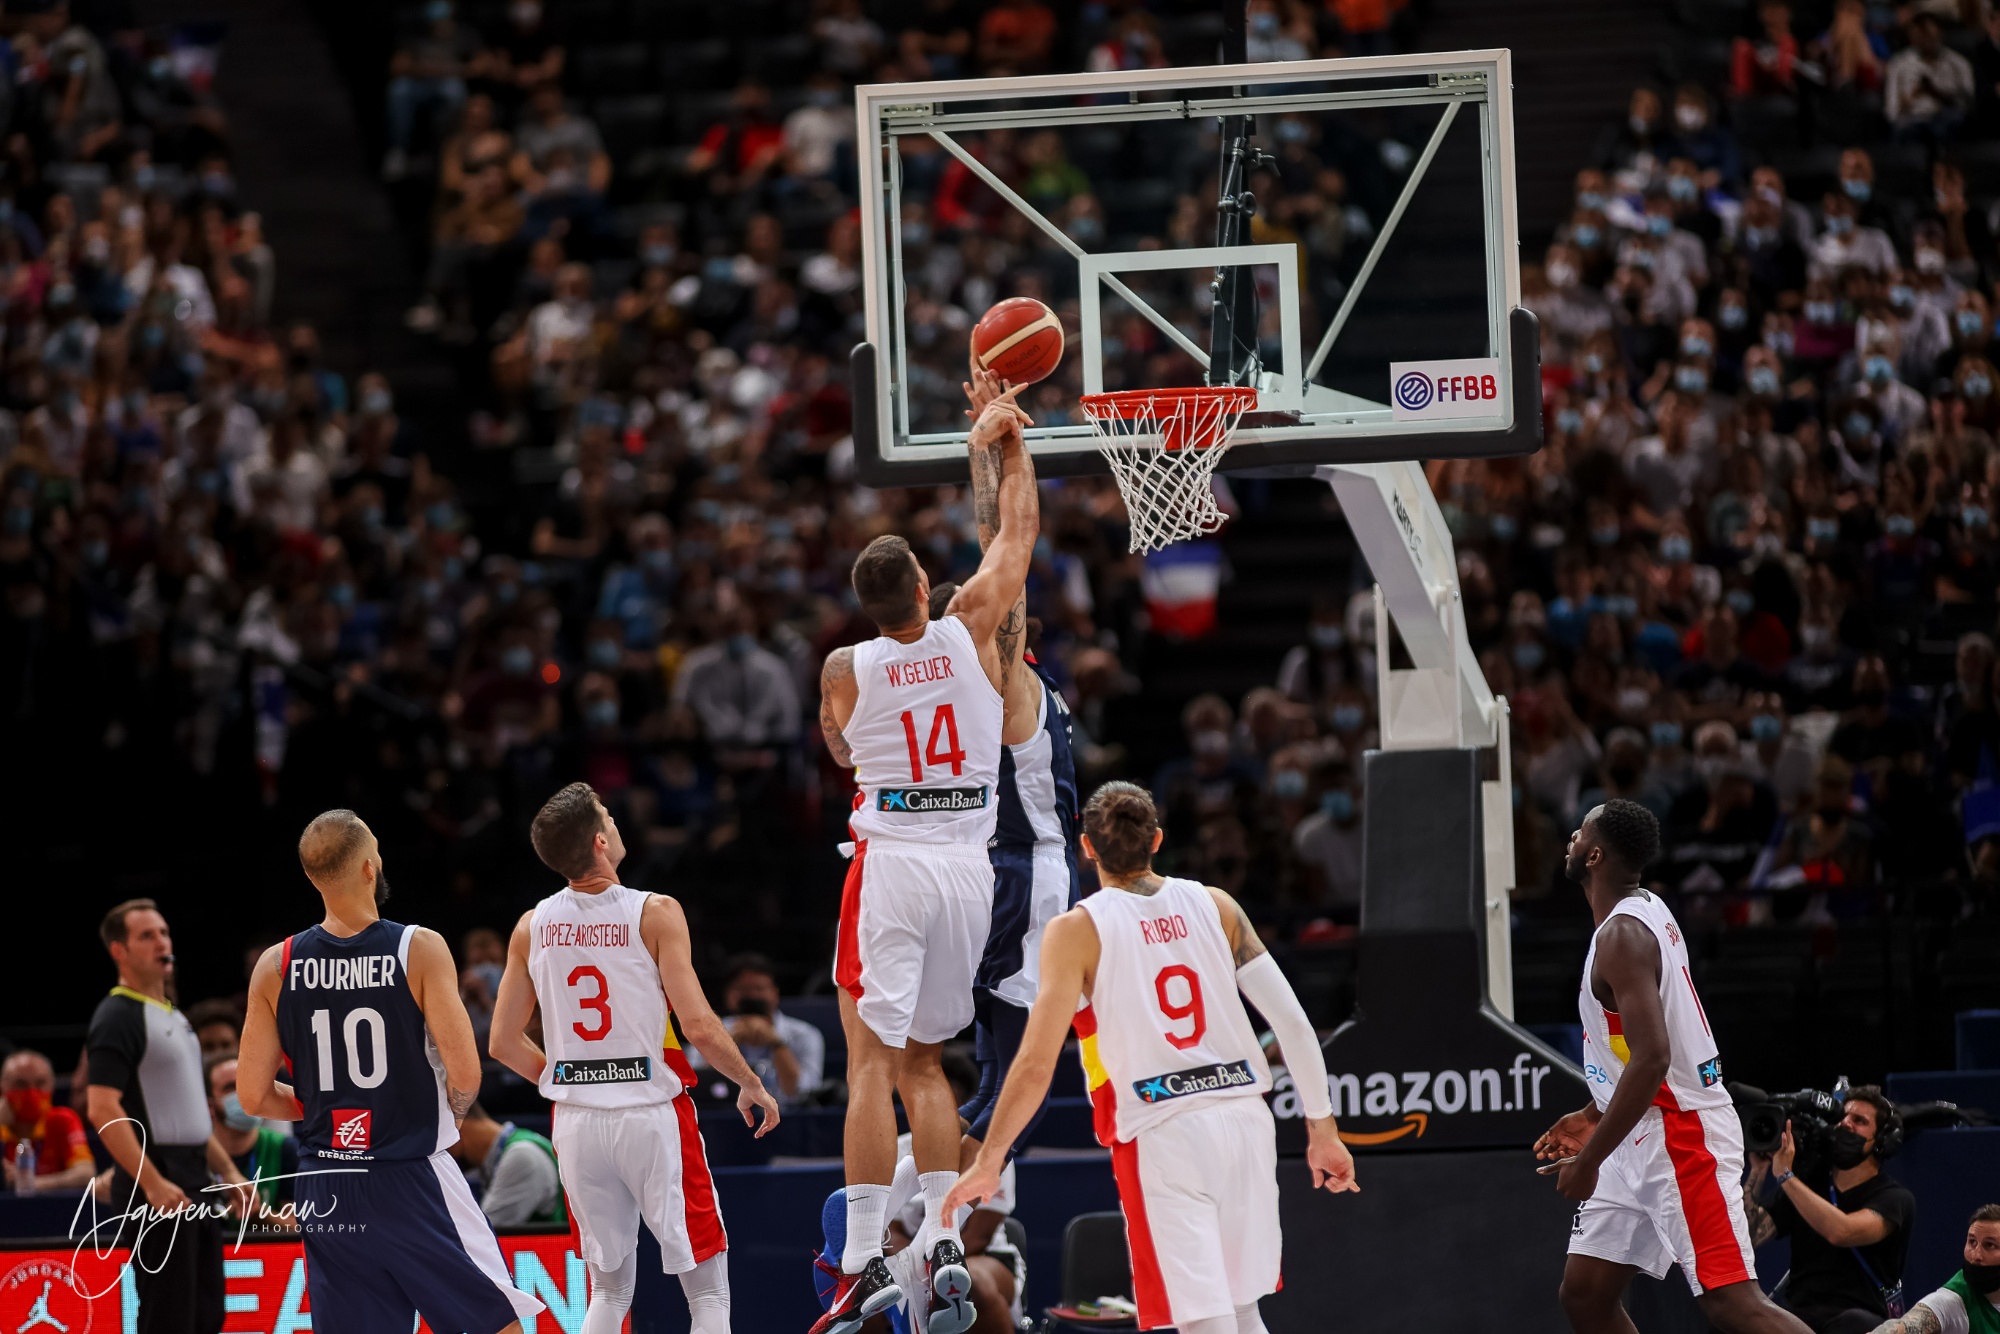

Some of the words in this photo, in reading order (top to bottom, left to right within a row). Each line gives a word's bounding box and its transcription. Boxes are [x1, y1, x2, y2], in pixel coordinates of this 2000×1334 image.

[1005, 344, 1041, 370] molten
[1437, 374, 1497, 403] FFBB
[885, 655, 955, 688] W.GEUER
[900, 703, 967, 783] 14
[905, 790, 985, 810] CaixaBank
[540, 919, 629, 949] LÓPEZ-AROSTEGUI
[1140, 914, 1188, 945] RUBIO
[290, 954, 396, 991] FOURNIER
[567, 965, 613, 1042] 3
[1154, 964, 1207, 1051] 9
[311, 1007, 388, 1092] 10
[562, 1061, 646, 1083] CaixaBank
[1166, 1065, 1253, 1094] CaixaBank
[1273, 1053, 1551, 1120] amazon.fr
